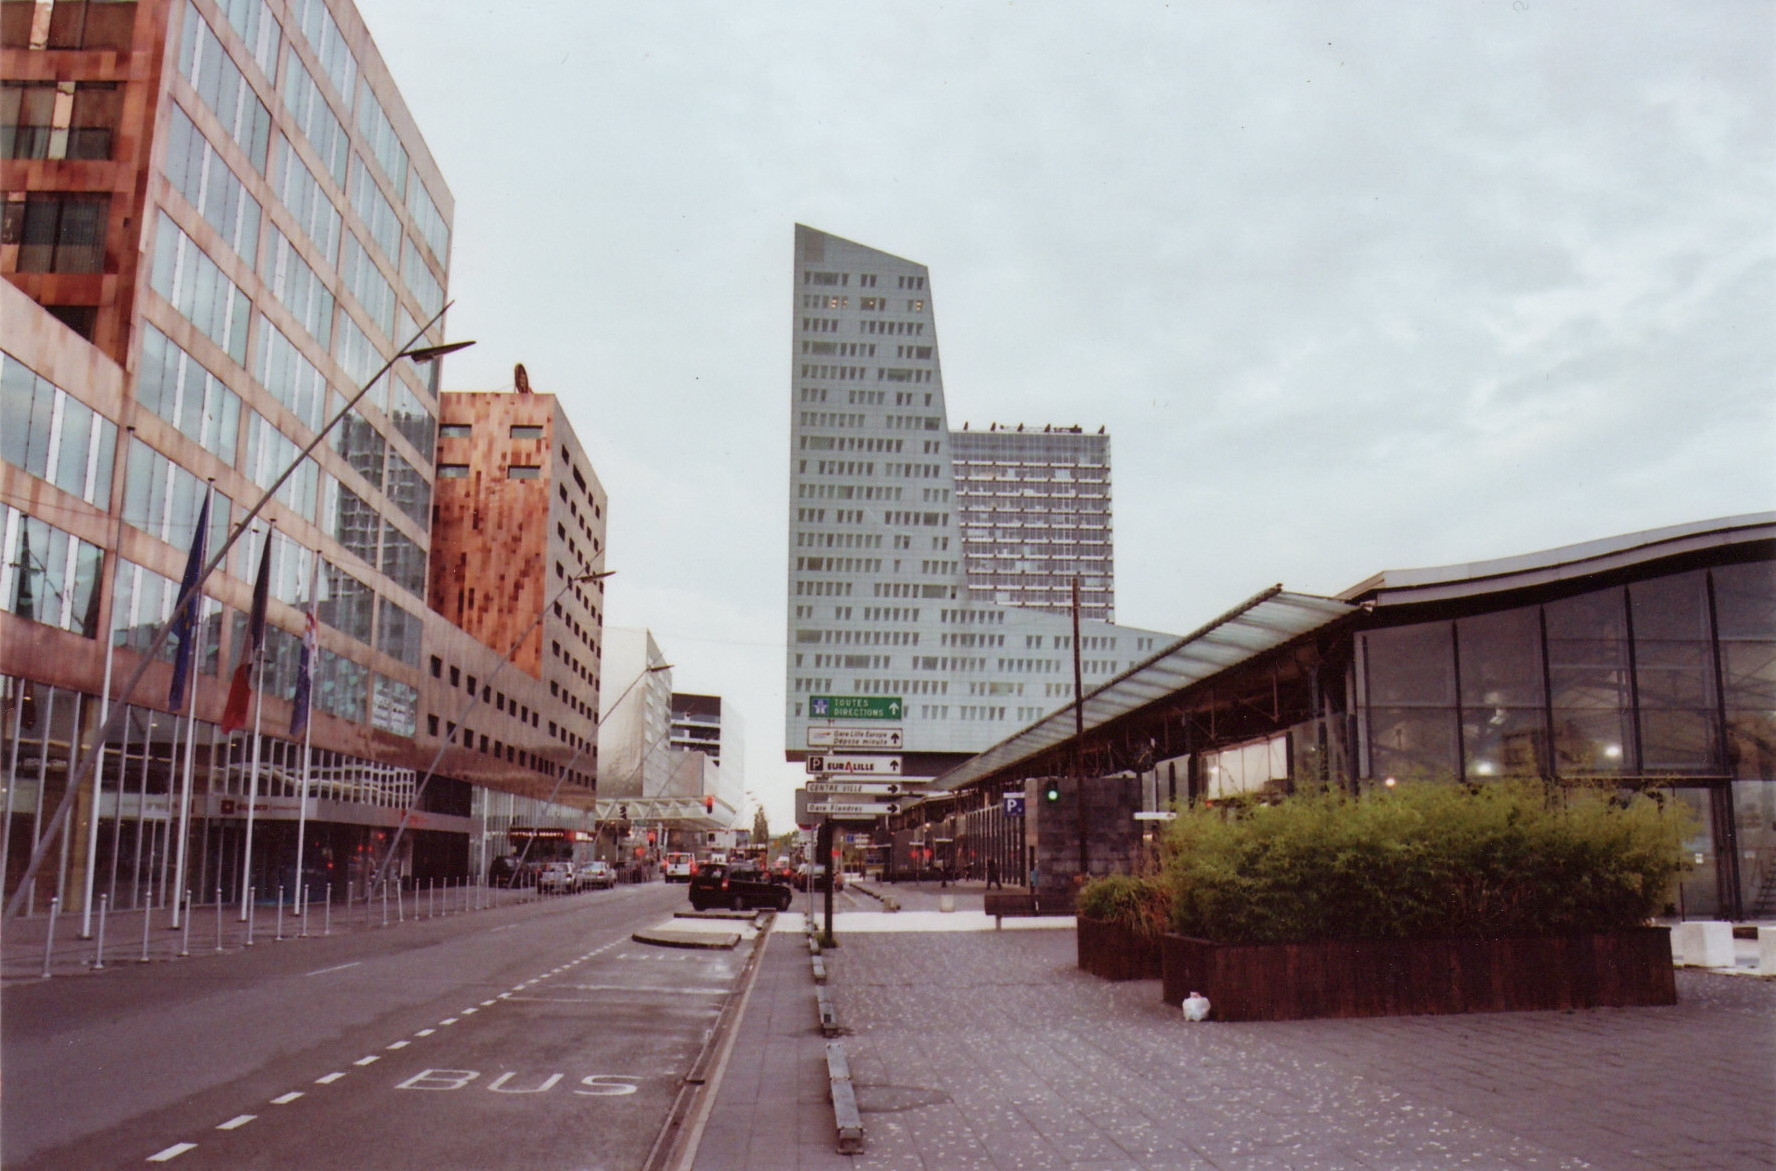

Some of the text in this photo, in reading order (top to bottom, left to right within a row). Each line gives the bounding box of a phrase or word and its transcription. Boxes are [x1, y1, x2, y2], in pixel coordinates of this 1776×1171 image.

[828, 761, 874, 773] EURALILLE
[1007, 798, 1018, 812] P
[394, 1068, 647, 1096] BUS
